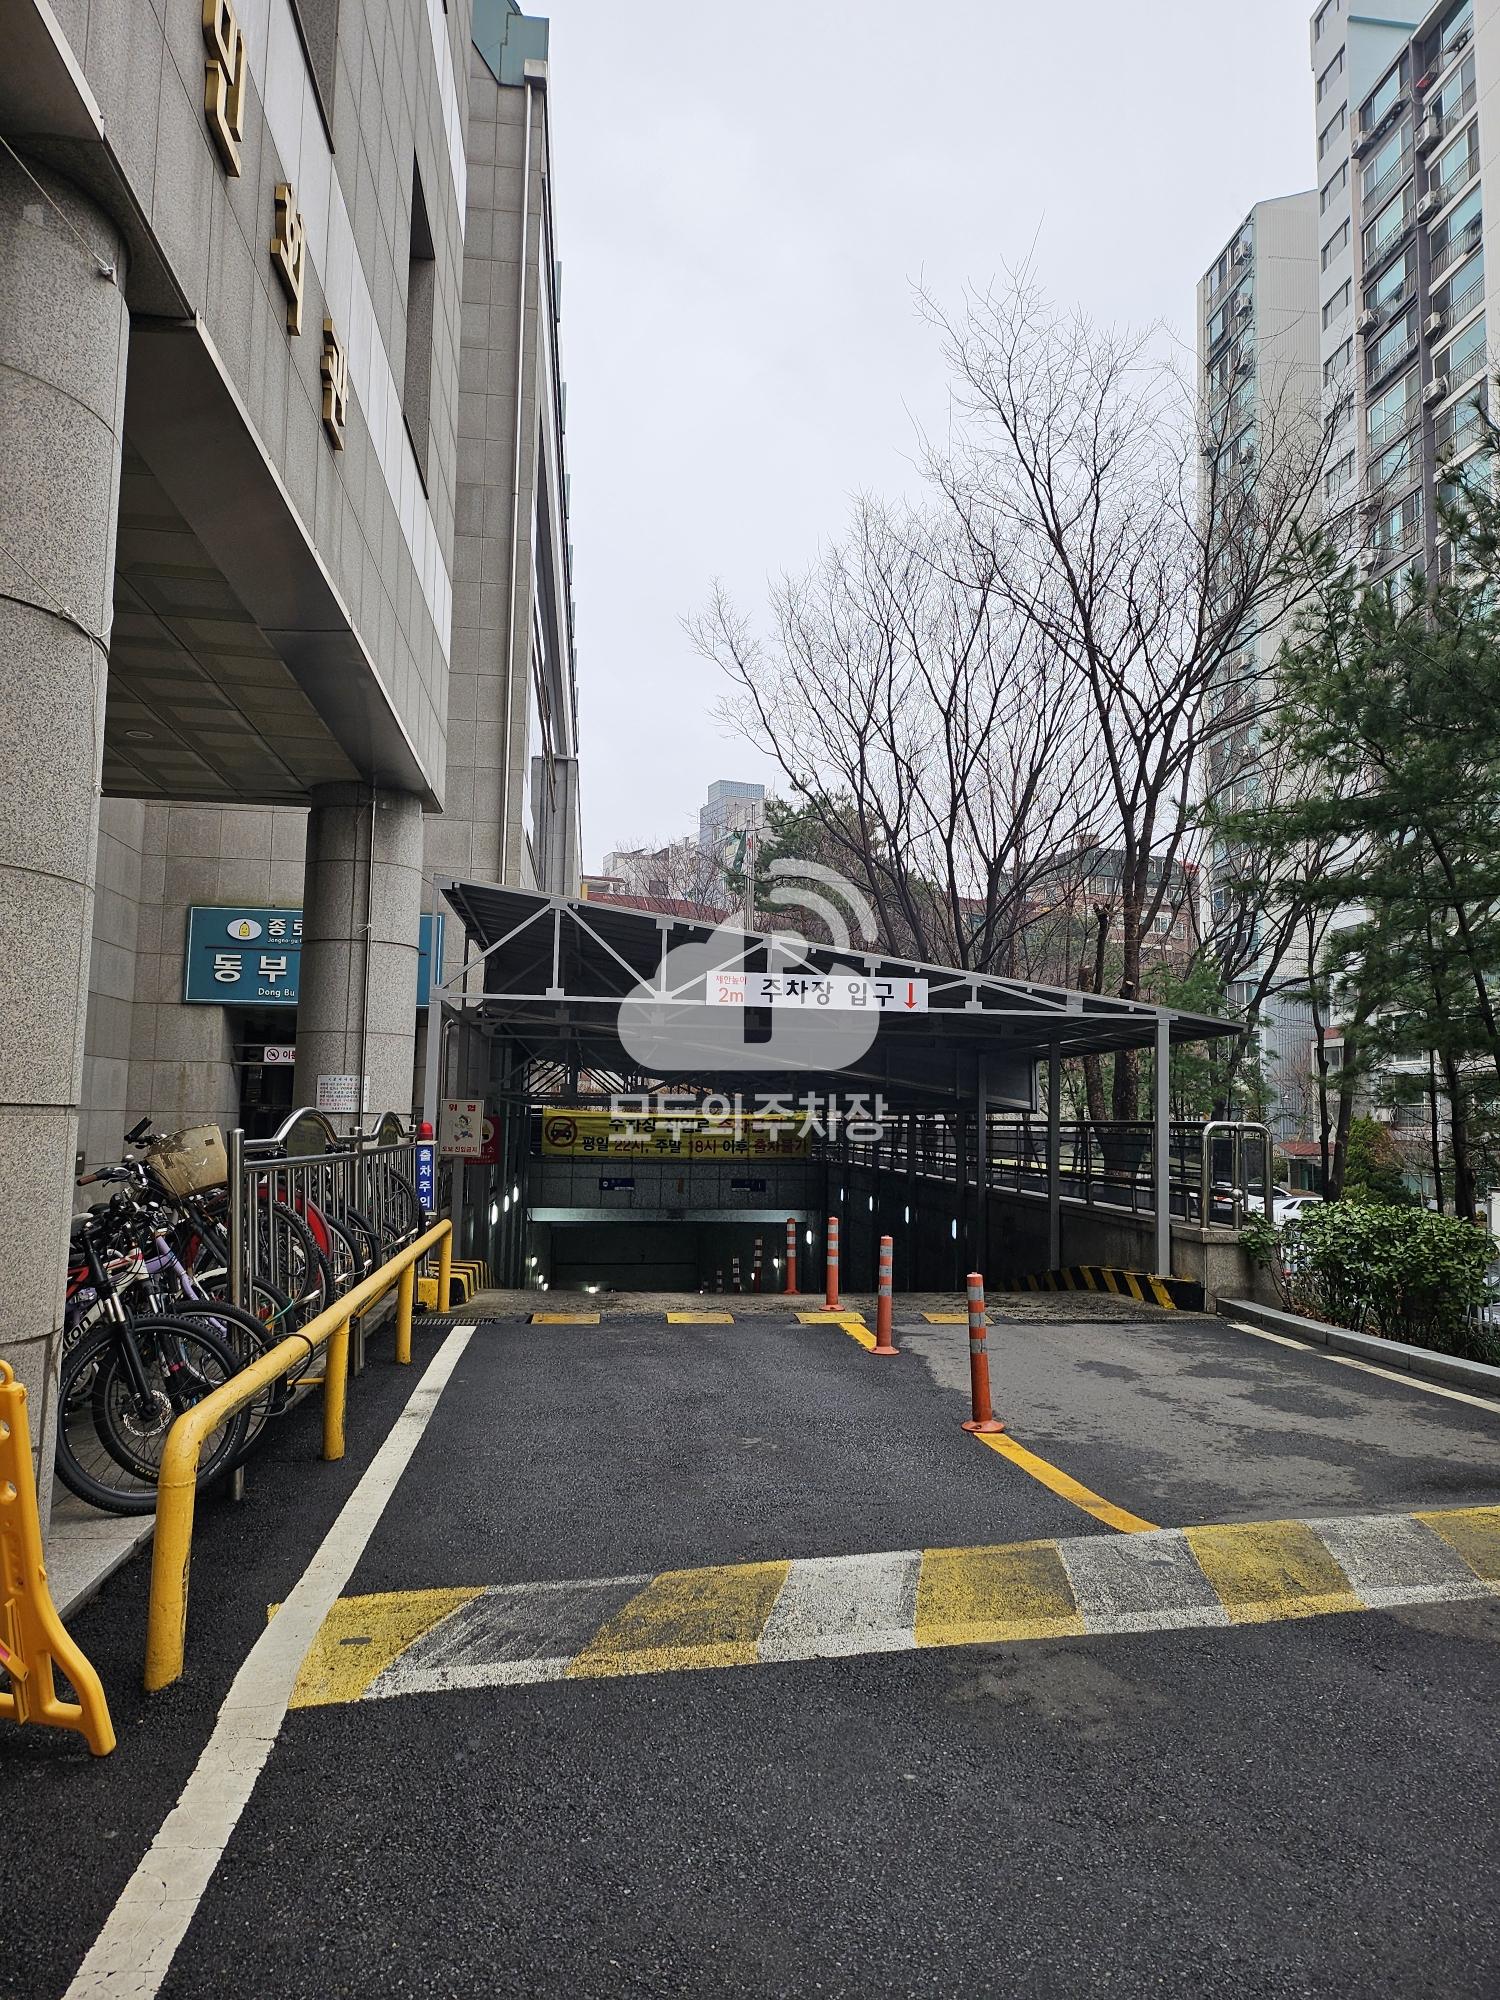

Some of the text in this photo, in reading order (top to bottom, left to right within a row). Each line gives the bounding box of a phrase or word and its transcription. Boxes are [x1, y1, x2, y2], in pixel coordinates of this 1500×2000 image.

[213, 953, 287, 983] 동부
[258, 987, 295, 997] Dong Bu
[718, 987, 744, 1003] 2m
[760, 978, 895, 1007] 주차장 입구
[582, 1136, 608, 1152] 평일
[655, 1139, 682, 1154] 주말
[688, 1139, 717, 1154] 18시
[722, 1139, 749, 1154] 이후
[419, 1149, 431, 1208] 출차주의
